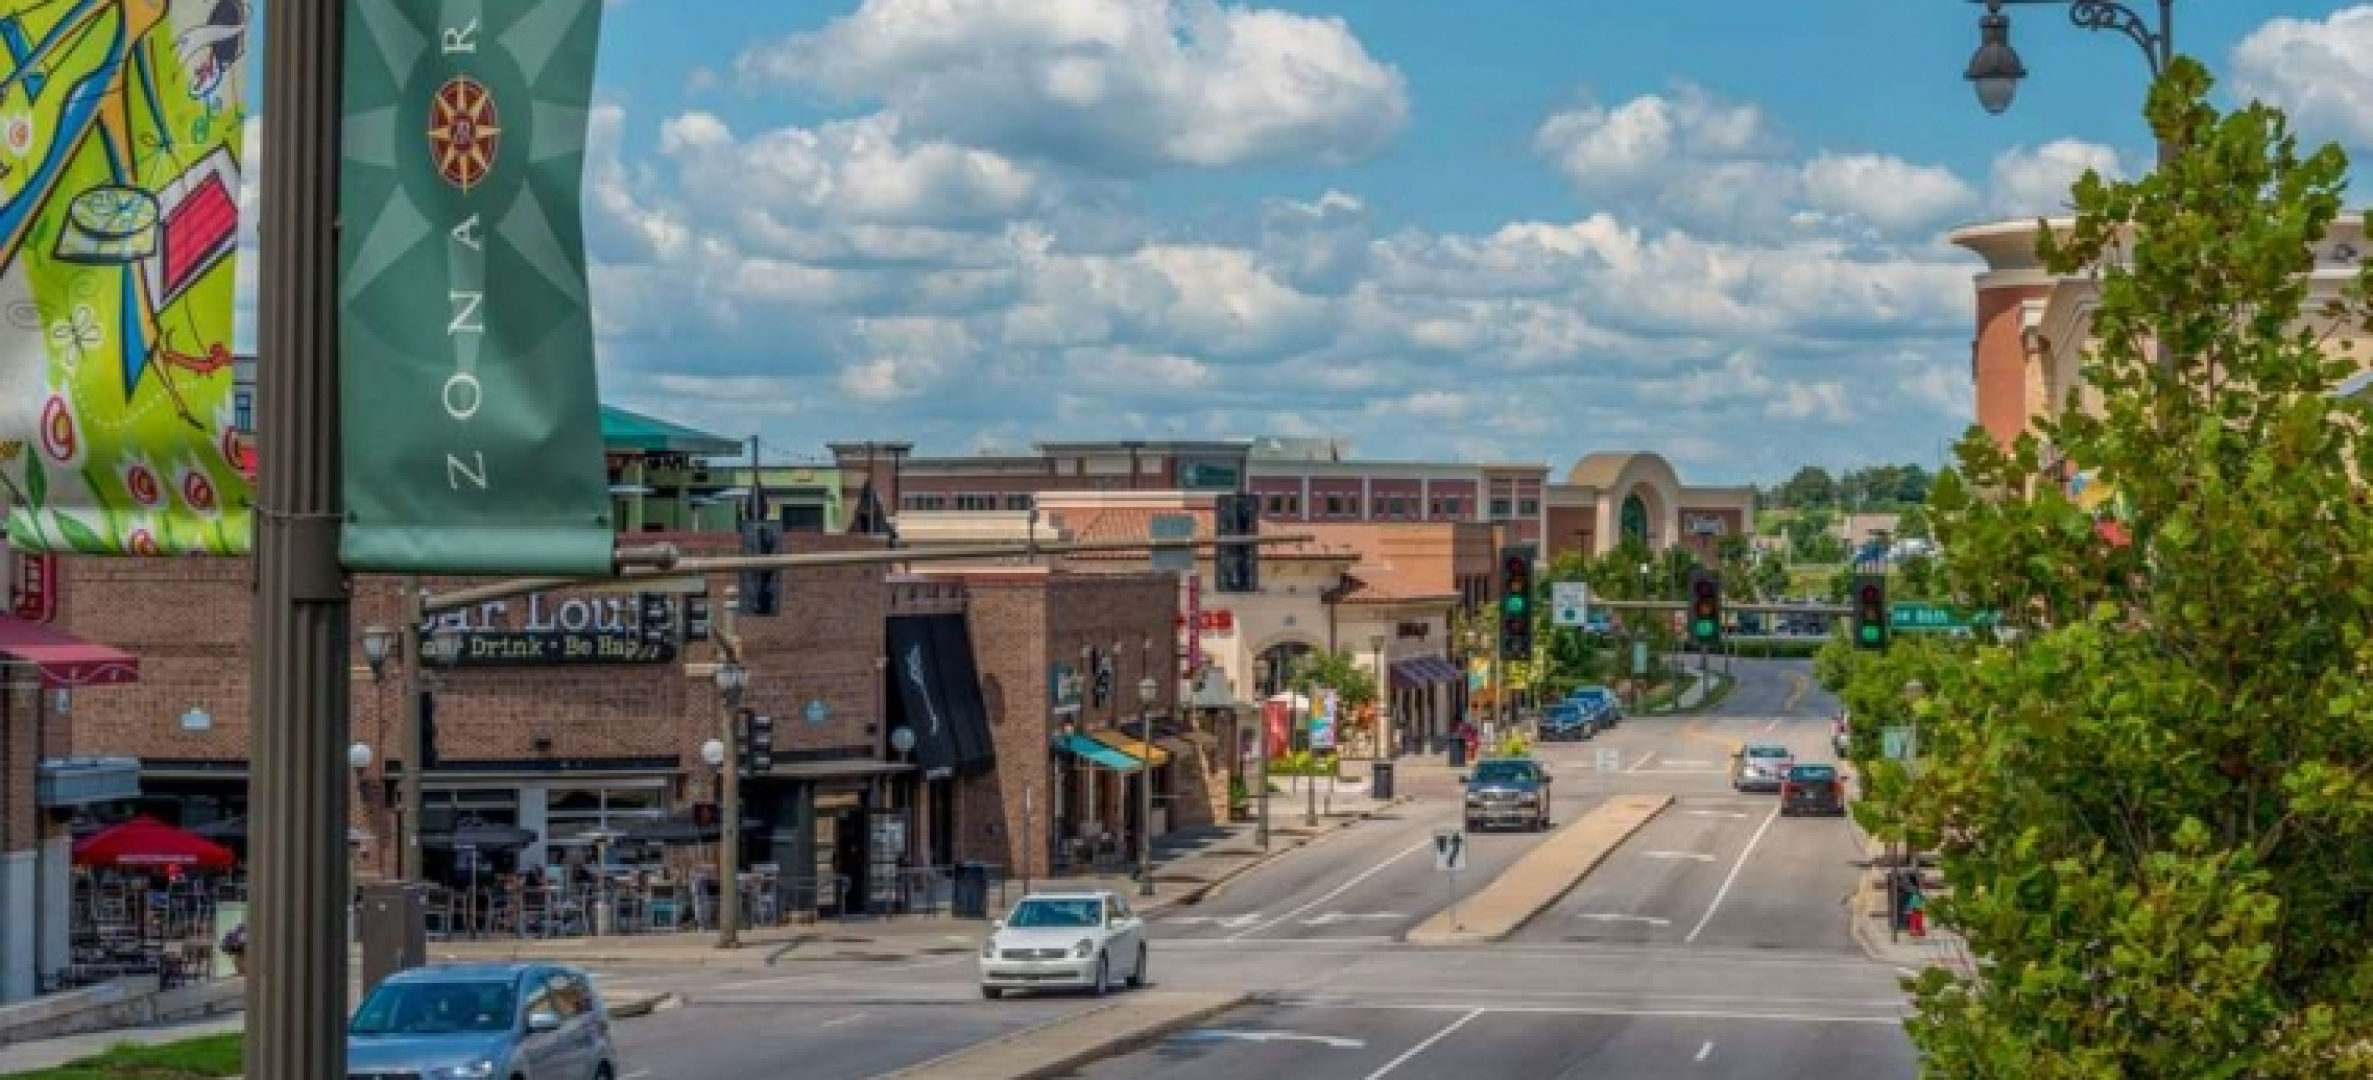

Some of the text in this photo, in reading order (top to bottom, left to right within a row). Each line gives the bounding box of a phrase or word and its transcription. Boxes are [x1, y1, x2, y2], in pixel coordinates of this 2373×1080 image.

[442, 212, 486, 491] ZONA
[471, 635, 545, 657] Drink
[565, 636, 593, 656] Be
